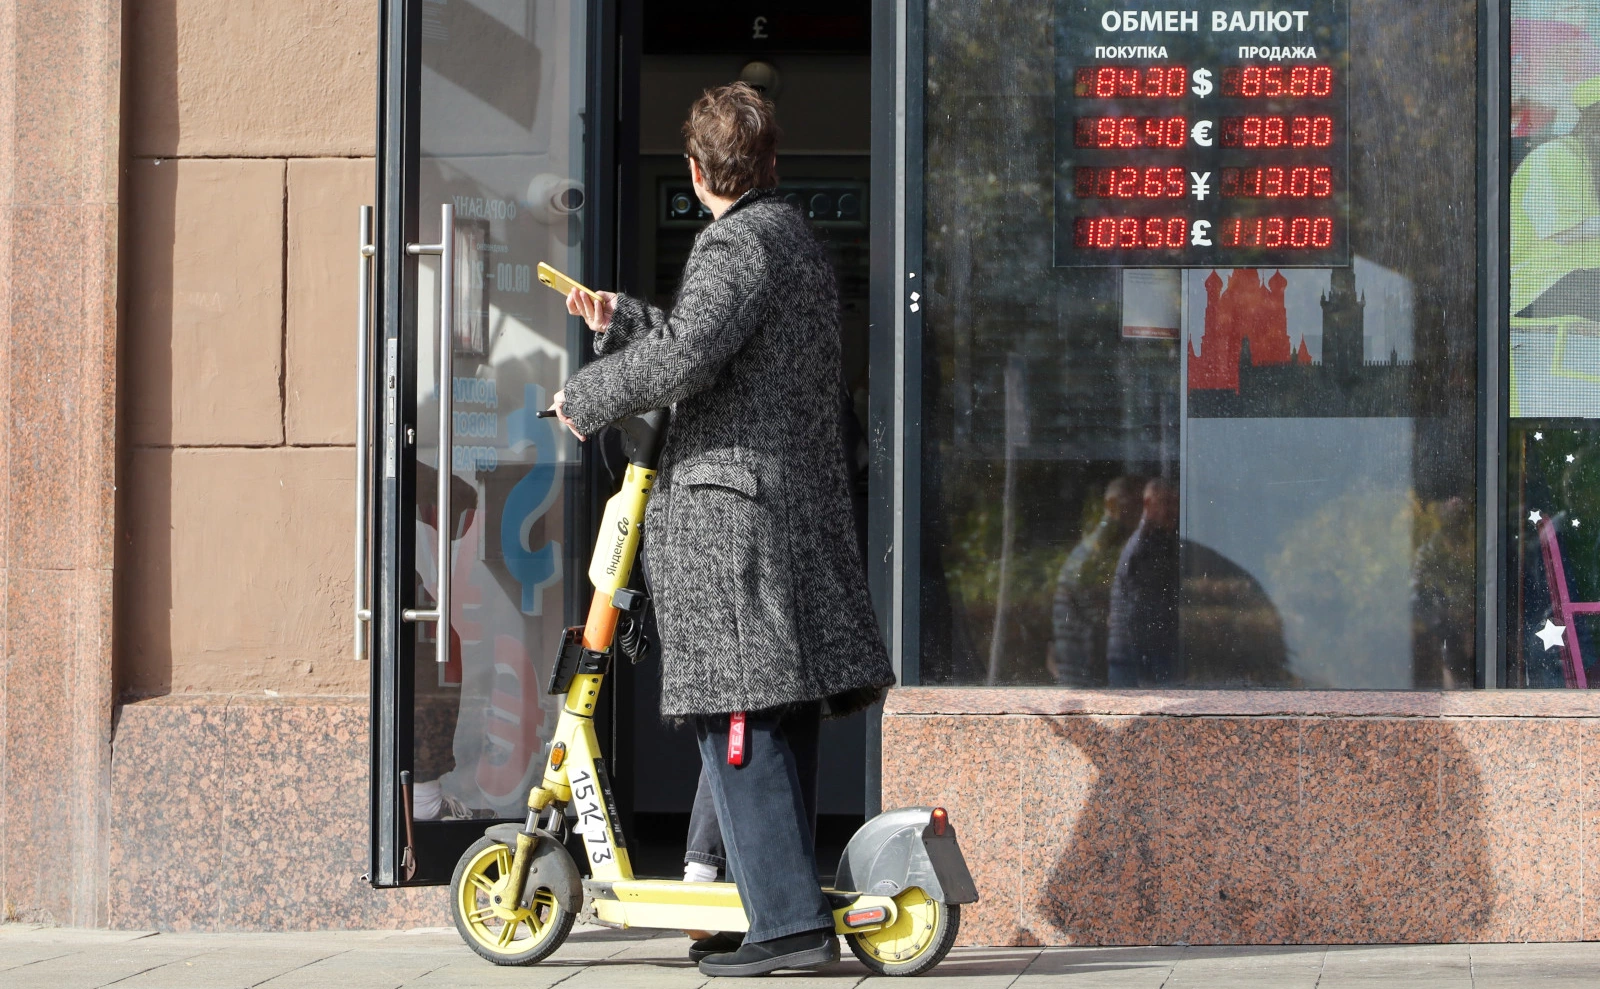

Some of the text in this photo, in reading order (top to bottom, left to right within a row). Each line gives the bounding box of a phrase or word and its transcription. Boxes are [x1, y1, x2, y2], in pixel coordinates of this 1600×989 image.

[752, 16, 769, 39] £
[1101, 10, 1309, 32] ОБМЕН ВАЛЮТ
[1095, 46, 1168, 59] ПОКУПКА
[1238, 46, 1317, 61] ПРОДАЖА
[1096, 66, 1332, 98] 84.30 $ 85.80
[1097, 117, 1332, 147] 96.40 € 98.30
[1108, 167, 1330, 200] 12.65 ¥ 13.05
[1088, 217, 1332, 247] 109.50 £ 113.00
[606, 516, 630, 577] Яндекс Go
